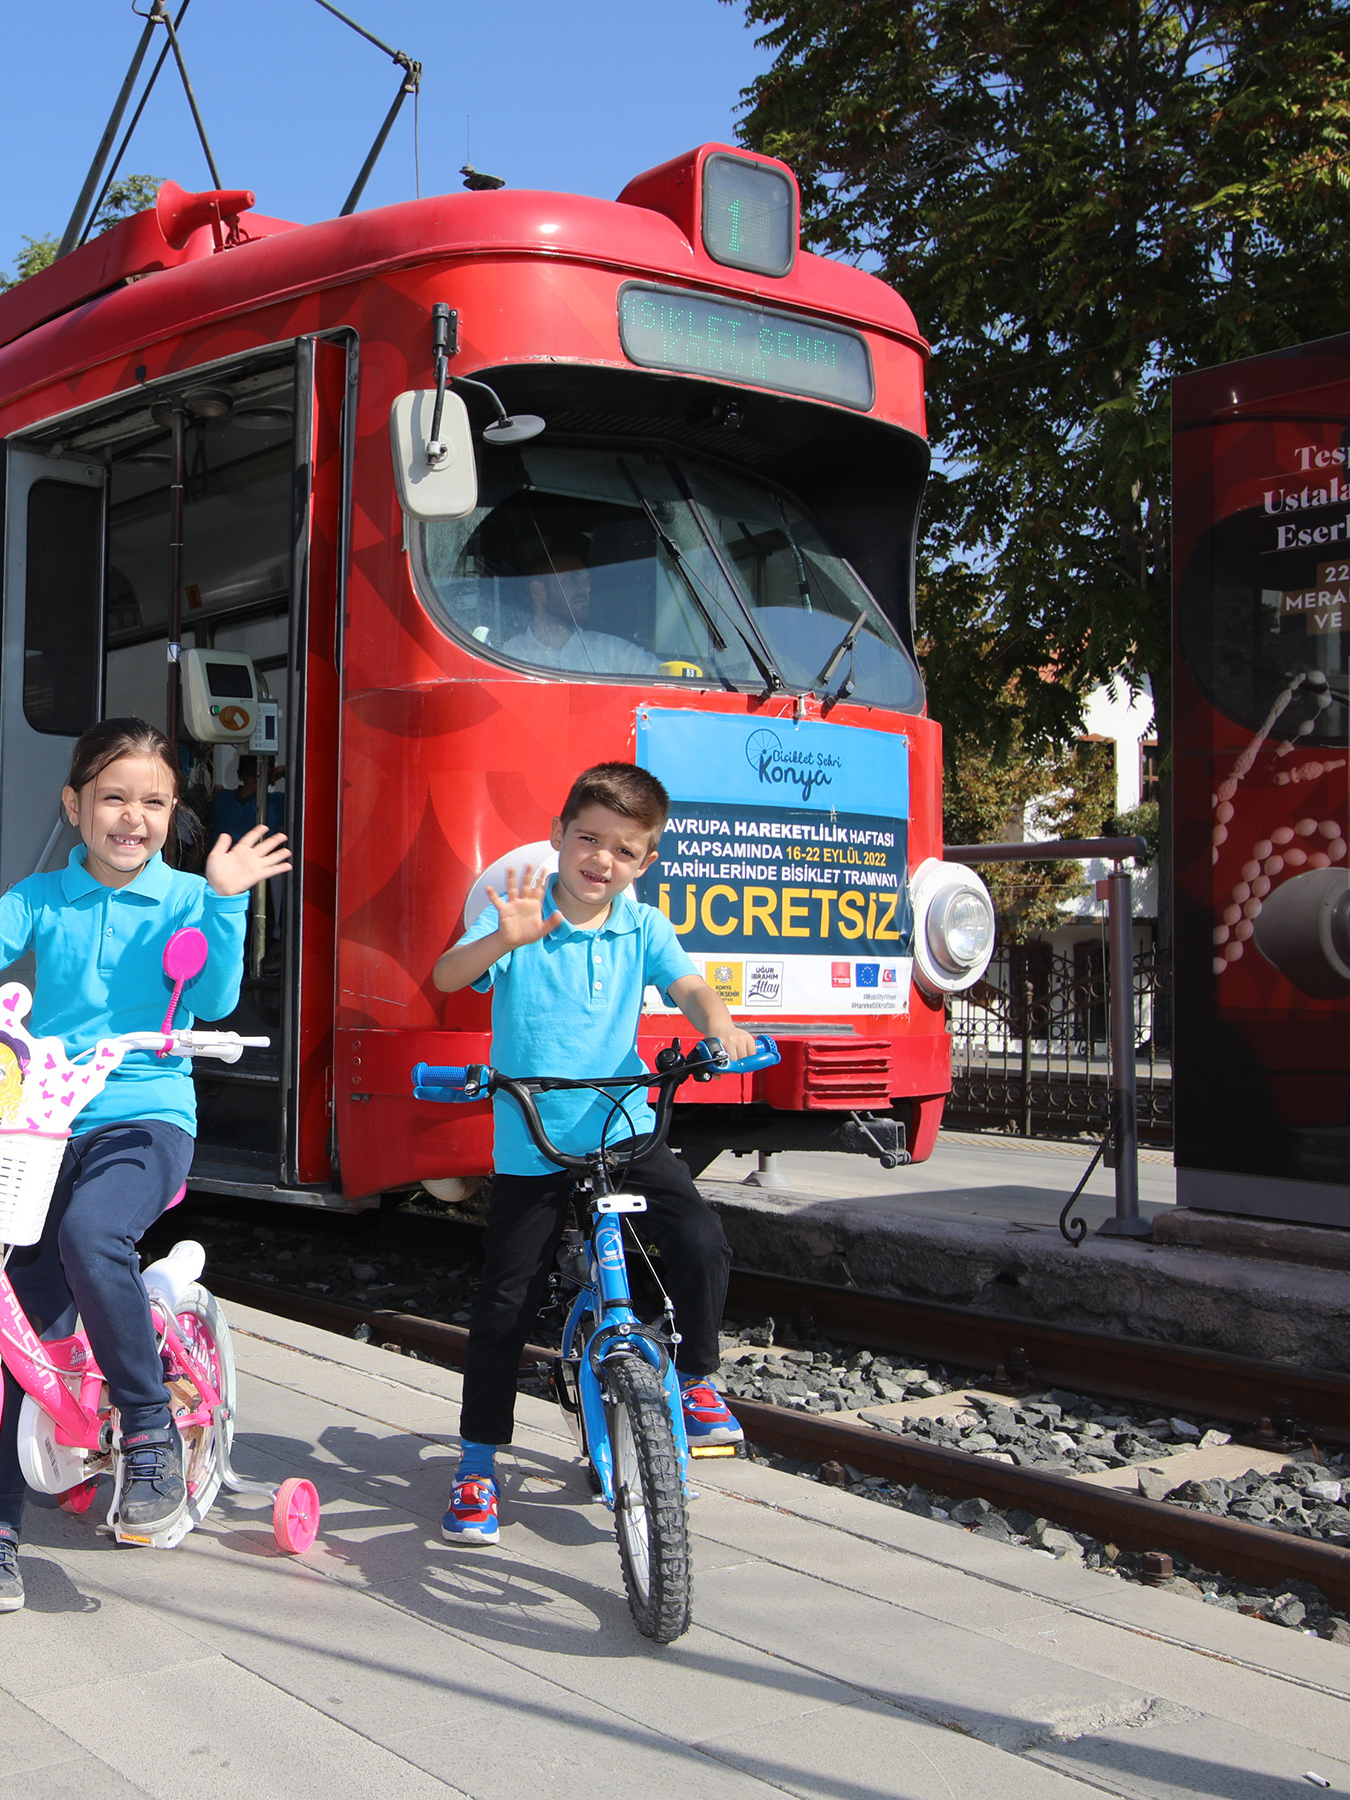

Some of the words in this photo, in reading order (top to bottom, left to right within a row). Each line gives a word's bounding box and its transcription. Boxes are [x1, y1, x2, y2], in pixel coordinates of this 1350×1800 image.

[727, 198, 741, 253] 1
[1293, 444, 1350, 472] Tes
[1285, 588, 1350, 611] MERA
[1314, 611, 1342, 629] VE
[772, 749, 815, 766] Bisiklet
[816, 752, 843, 770] Şehri
[758, 753, 833, 803] Konya
[663, 817, 731, 836] AVRUPA
[734, 821, 848, 844] HAREKETLİLİK
[849, 828, 895, 848] HAFTASI
[677, 840, 783, 860] KAPSAMINDA
[786, 845, 821, 862] 16-22
[823, 846, 862, 866] EYLÜL
[863, 851, 887, 867] 2022
[660, 858, 778, 881] TARİHLERİNDE
[781, 862, 841, 884] BİSİKLET
[843, 869, 899, 888] TRAMVAYI
[658, 882, 900, 941] ÜCRETSİZ
